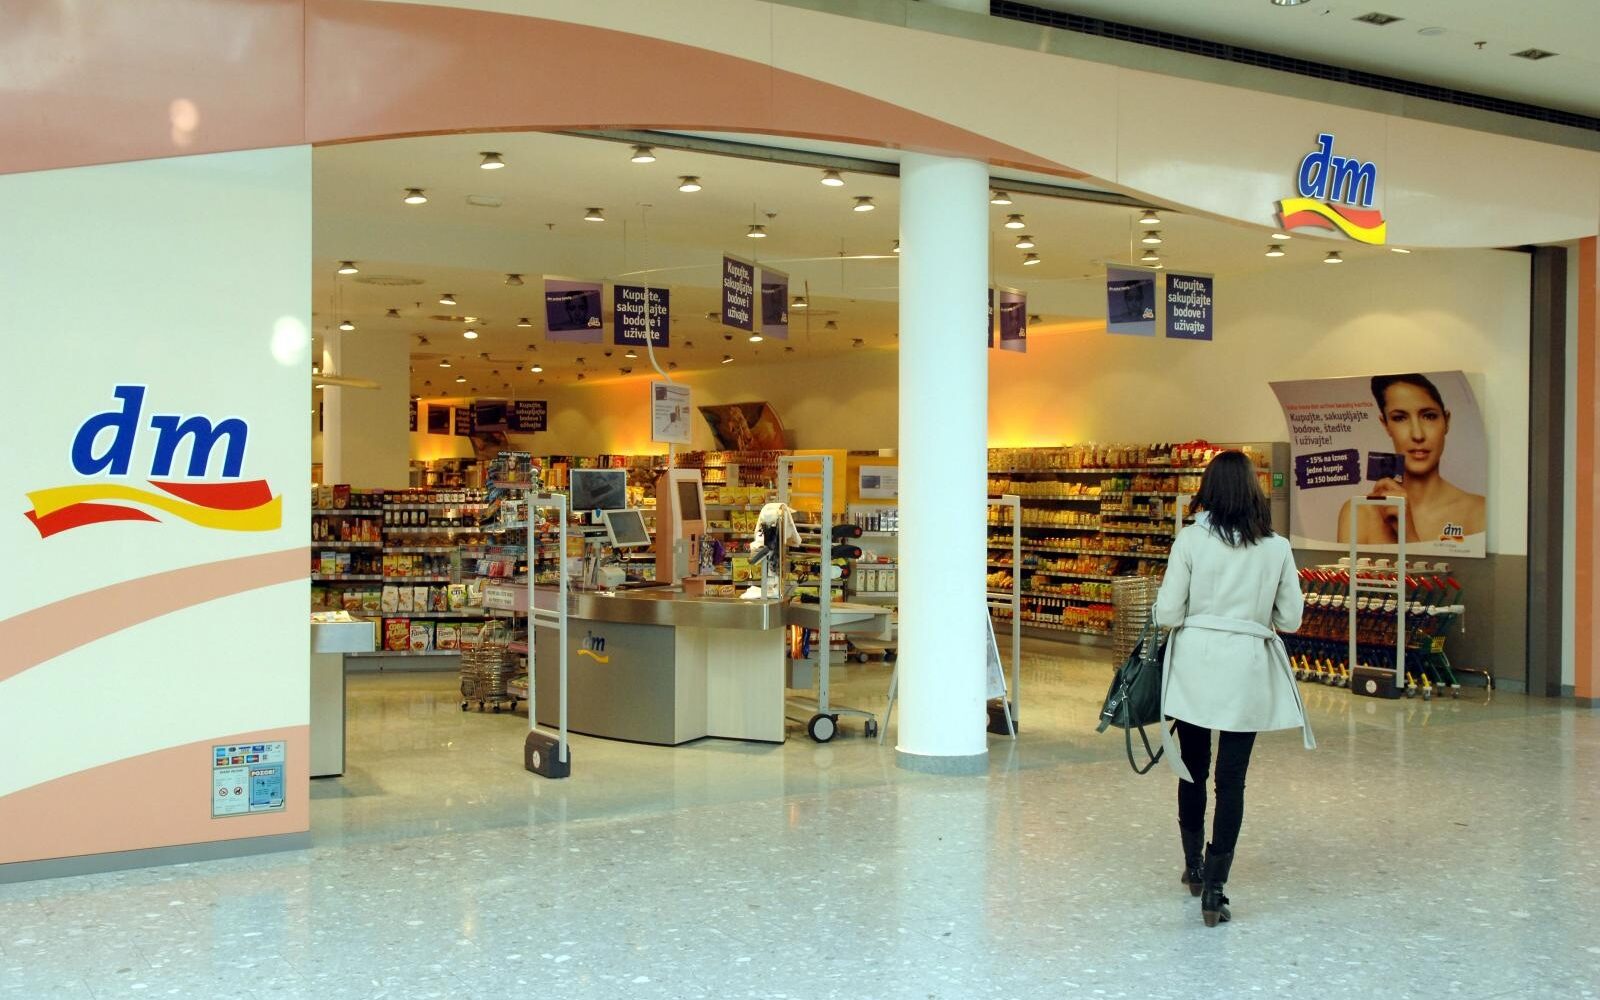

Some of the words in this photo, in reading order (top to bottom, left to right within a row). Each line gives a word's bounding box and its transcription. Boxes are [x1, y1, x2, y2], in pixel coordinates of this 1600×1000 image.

[1299, 133, 1377, 207] dm
[727, 261, 750, 281] Kupujte,
[723, 277, 753, 296] sakupljajte
[1173, 278, 1206, 293] Kupujte,
[622, 288, 661, 303] Kupute,
[727, 290, 746, 308] bodove
[1167, 292, 1211, 307] sakupljajte
[727, 306, 749, 324] uživajte
[1173, 305, 1201, 318] bodove
[1174, 320, 1205, 335] uživajte
[1289, 412, 1323, 424] Kupujte,
[1324, 410, 1369, 423] sakupljajte
[71, 384, 249, 478] dm
[1293, 424, 1323, 434] bodove,
[1324, 422, 1352, 433] štedite
[1299, 435, 1333, 447] uživajte!
[1310, 456, 1323, 464] 15%
[1332, 454, 1348, 462] iznos
[1306, 466, 1323, 476] jedne
[1323, 464, 1344, 475] kupnje
[1315, 476, 1326, 484] 150
[1326, 473, 1349, 482] bodova!
[1443, 523, 1462, 536] dm
